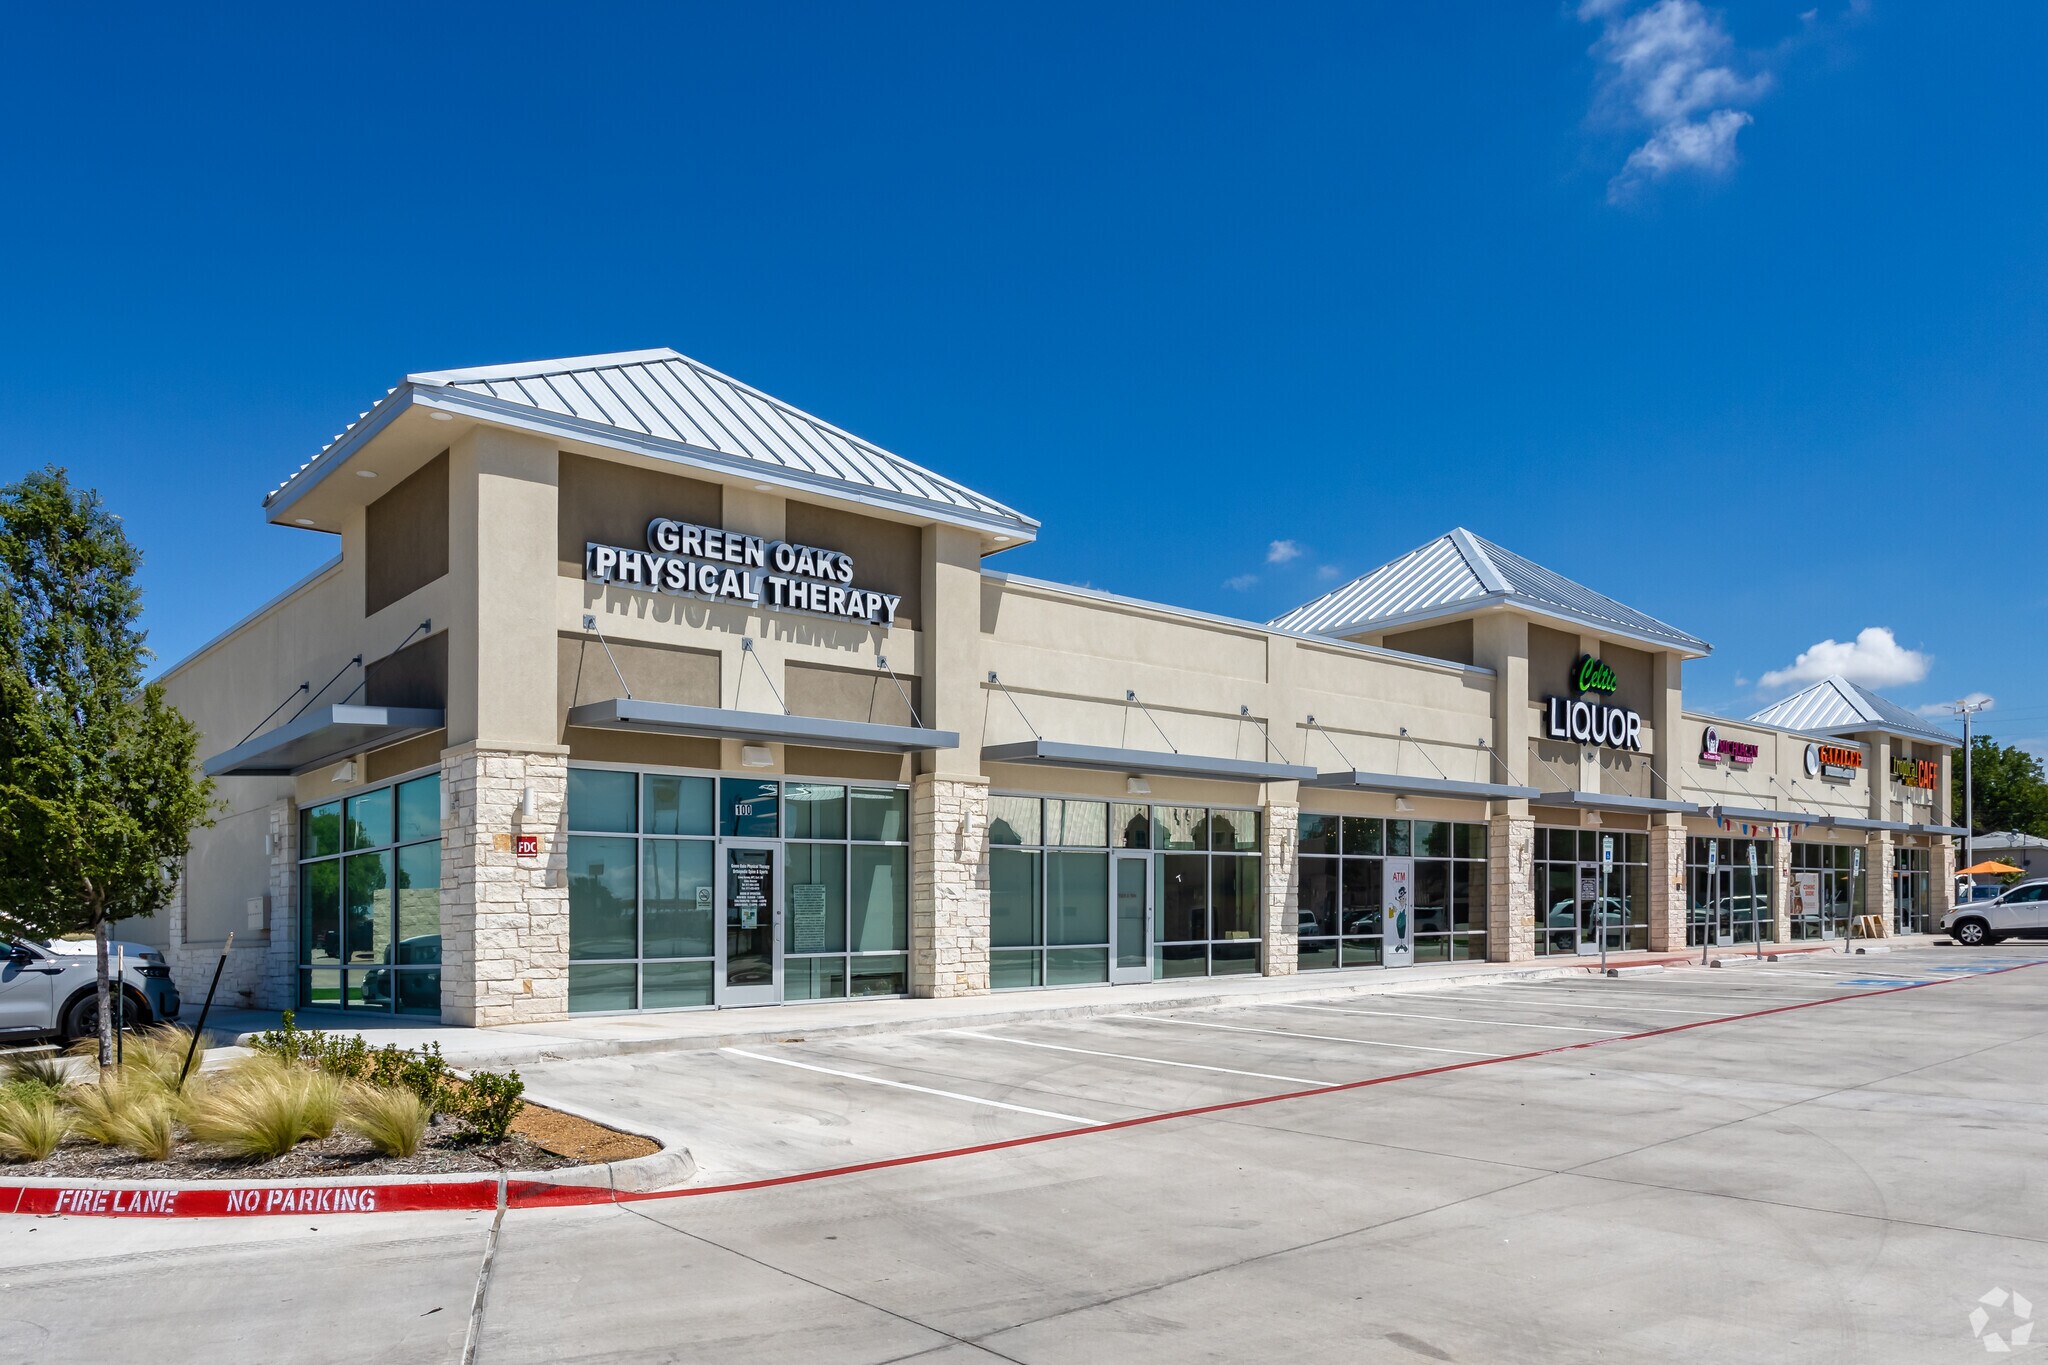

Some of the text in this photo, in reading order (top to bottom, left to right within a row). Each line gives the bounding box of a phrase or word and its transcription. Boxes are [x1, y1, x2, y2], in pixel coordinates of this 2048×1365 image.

[656, 520, 854, 583] GREEN OAKS
[596, 546, 901, 623] PHYSICAL THERAPY
[1579, 657, 1617, 692] Celtic
[1551, 697, 1642, 748] LIQUOR
[1820, 745, 1862, 767] GALILEE
[1918, 760, 1938, 791] CAFE
[736, 805, 752, 815] 100
[518, 842, 536, 852] FDC
[1393, 872, 1405, 880] ATM
[55, 1189, 376, 1213] FIRE LANE NO PARKING
